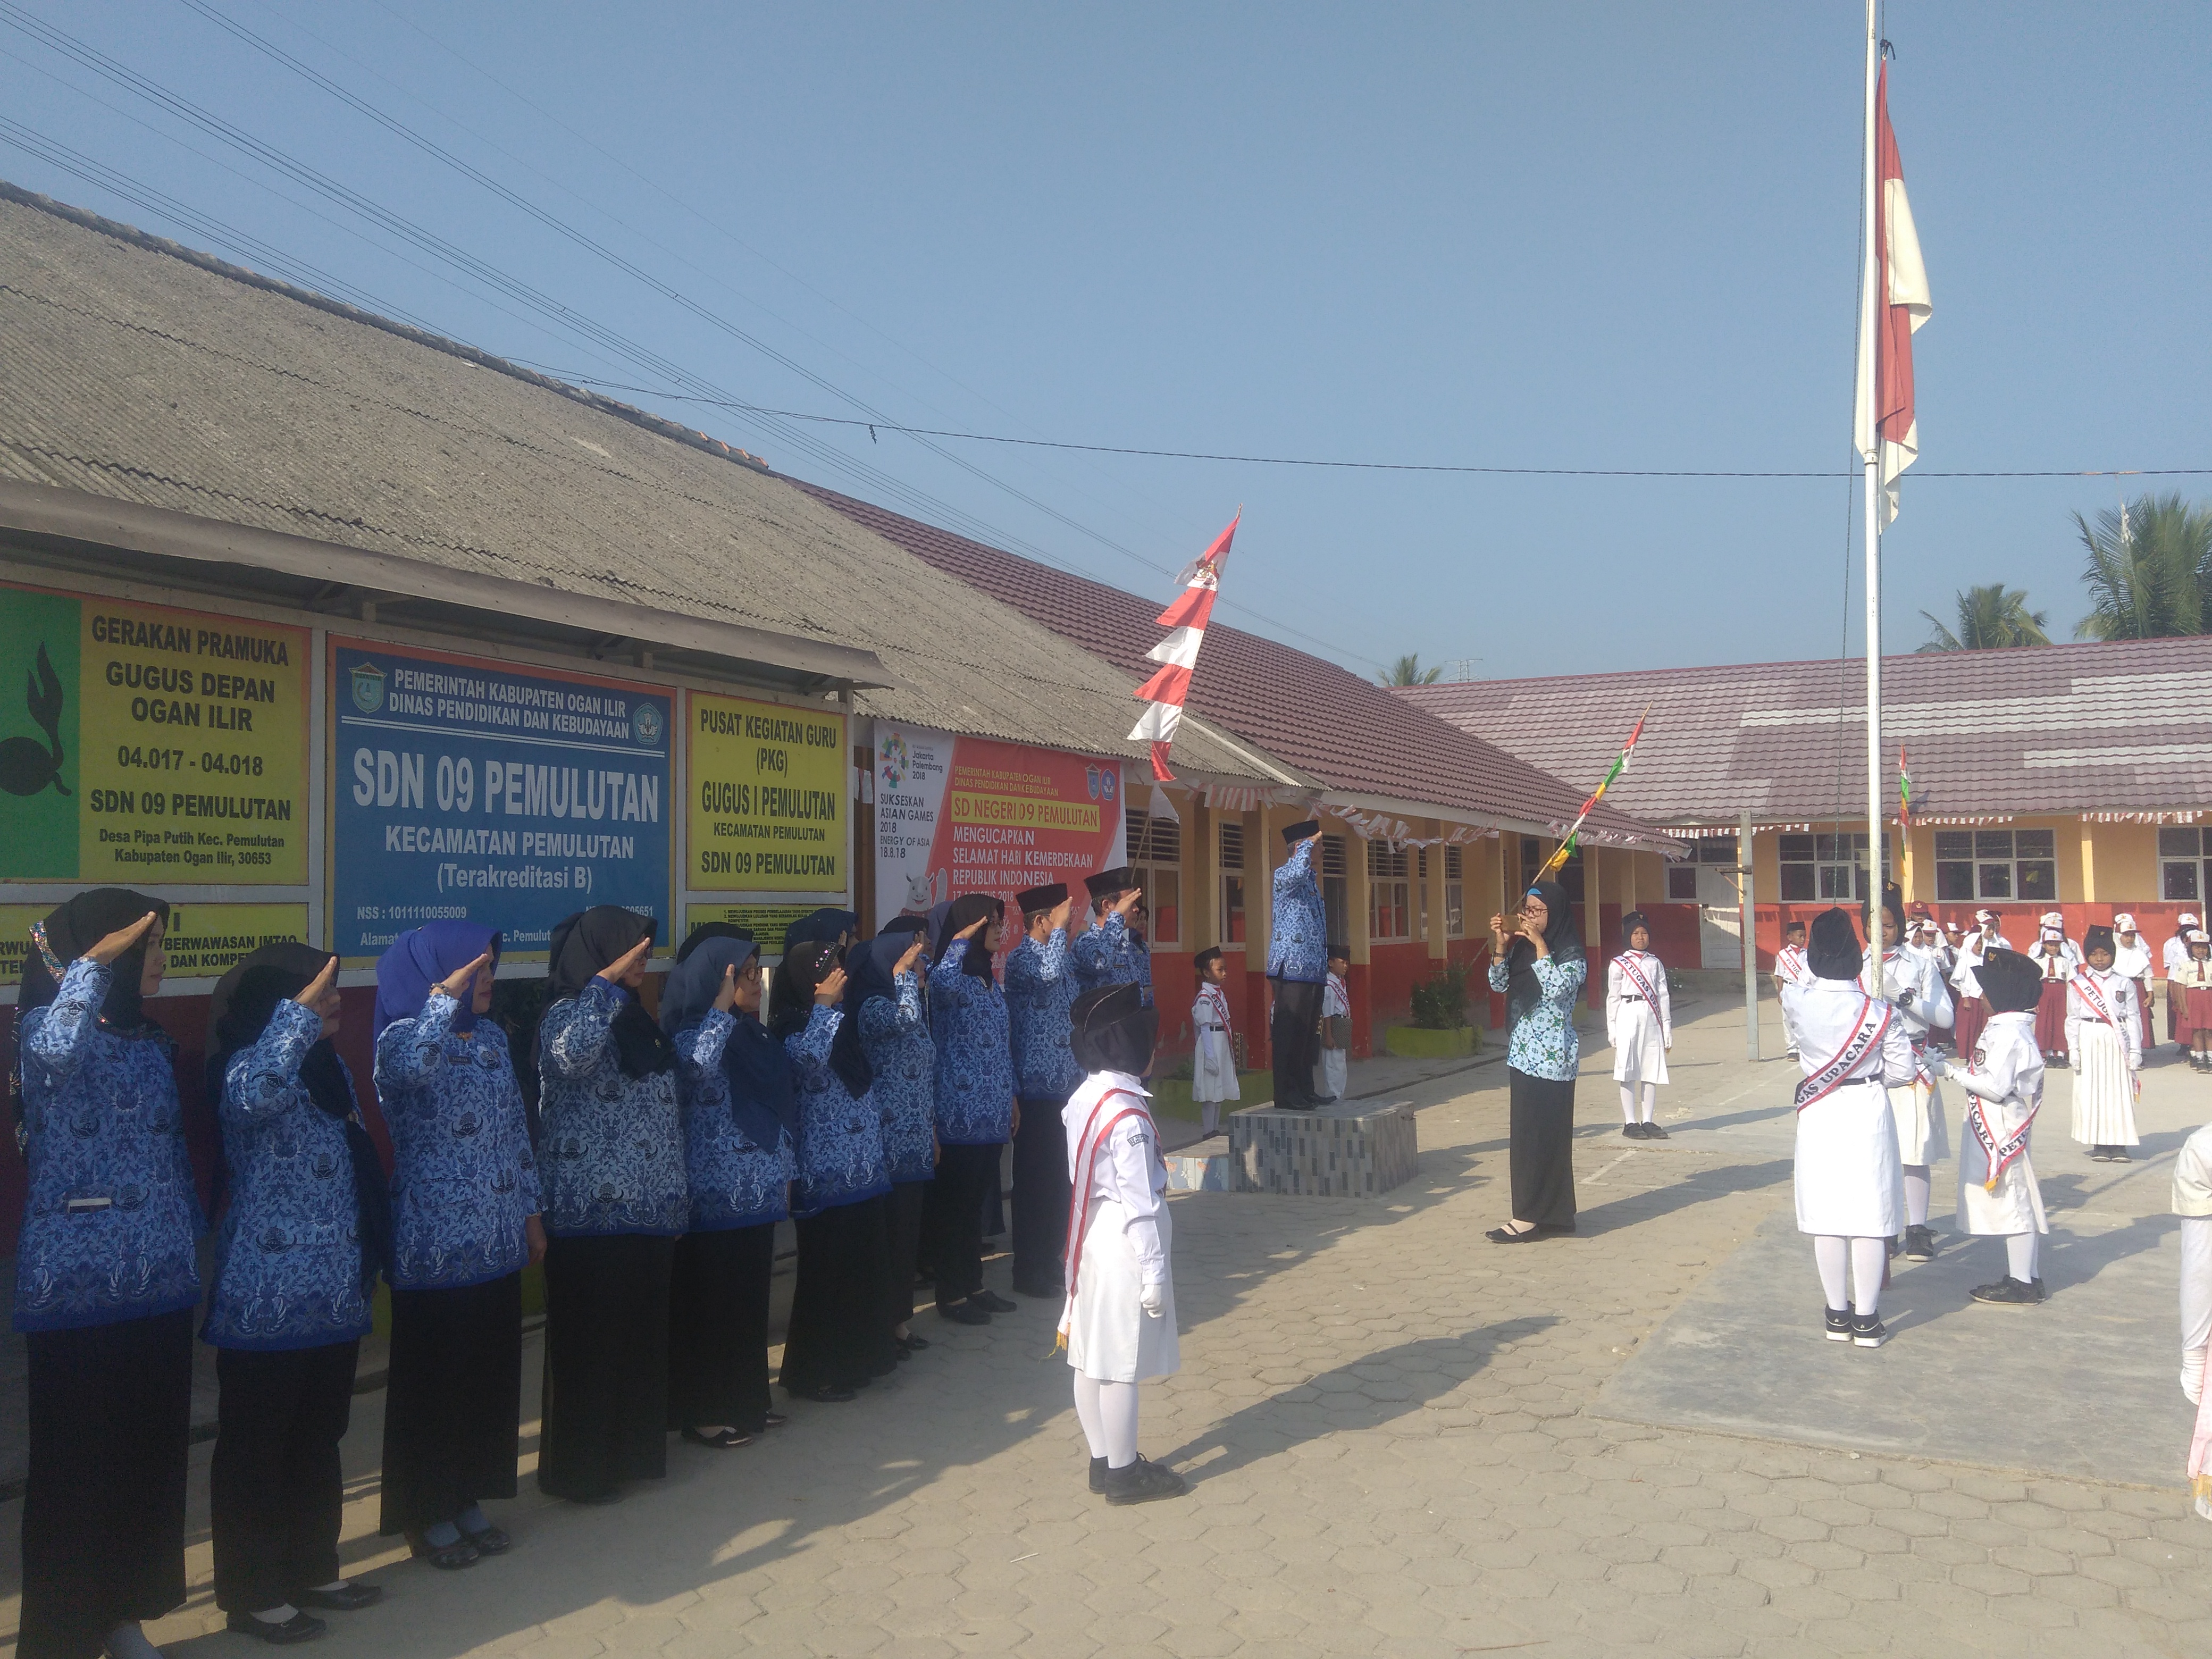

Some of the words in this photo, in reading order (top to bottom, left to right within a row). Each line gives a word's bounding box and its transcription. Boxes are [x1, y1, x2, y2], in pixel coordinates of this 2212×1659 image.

[92, 615, 191, 654] GERAKAN
[197, 630, 289, 666] PRAMUKA
[106, 661, 193, 694] GUGUS
[202, 672, 275, 702] DEPAN
[395, 668, 485, 699] PEMERINTAH
[489, 682, 564, 710] KABUPATEN
[567, 693, 601, 715] OGAN
[604, 699, 626, 717] ILIR
[131, 697, 200, 727] OGAN
[208, 705, 253, 731] ILIR
[389, 692, 433, 717] DINAS
[437, 699, 520, 727] PENDIDIKAN
[523, 710, 549, 730] DAN
[552, 715, 630, 740] KEBUDAYAAN
[701, 709, 741, 736] PUSAT
[745, 715, 803, 744] KEGIATAN
[806, 724, 836, 749] GURU
[118, 746, 183, 770] 04.017
[202, 752, 263, 776] 04.018
[756, 748, 788, 778] (PKG)
[912, 751, 934, 761] Jakarta
[912, 760, 943, 773] Palembang
[913, 771, 925, 780] 2018
[955, 766, 990, 777] PEMERINTAH
[992, 770, 1021, 782] KABUPATEN
[1023, 774, 1041, 784] OGAN
[1042, 776, 1051, 785] ILIR
[352, 747, 424, 809] SDN
[436, 755, 474, 812] 09
[485, 760, 658, 823] PEMULUTAN
[955, 777, 973, 787] DINAS
[975, 780, 1008, 791] PENDIDIKAN
[90, 789, 135, 814] SDN
[142, 792, 165, 815] 09
[172, 793, 291, 821] PEMULUTAN
[702, 781, 749, 815] GUGUS
[754, 785, 757, 815] I
[762, 786, 835, 821] PEMULUTAN
[881, 793, 924, 807] SUKSESKAN
[881, 808, 905, 820] ASIAN
[908, 810, 933, 822] GAMES
[954, 797, 970, 816] SD
[975, 799, 1016, 820] NEGERI
[1020, 803, 1034, 820] 09
[1038, 805, 1097, 826] PEMULUTAN
[714, 822, 770, 839] KECAMATAN
[773, 826, 825, 841] PEMULUTAN
[881, 822, 896, 833] 2018
[953, 826, 1034, 845] MENGUCAPKAN
[99, 829, 130, 843] Desa
[134, 830, 161, 847] Pipa
[164, 831, 194, 845] Putih
[198, 832, 223, 847] Kec.
[227, 834, 284, 848] Pemulutan
[386, 825, 516, 856] KECAMATAN
[522, 831, 633, 859] PEMULUTAN
[881, 835, 904, 845] ENERGY
[917, 838, 930, 847] ASIA
[115, 849, 180, 866] Kabupaten
[183, 851, 213, 867] Ogan
[216, 851, 234, 866] Ilir,
[238, 852, 272, 865] 30653
[881, 847, 906, 858] 18.8.18
[953, 848, 998, 864] SELAMAT
[1001, 849, 1021, 865] HARI
[1025, 851, 1093, 868] KEMERDEKAAN
[701, 851, 731, 874] SDN
[735, 852, 751, 874] 09
[756, 854, 835, 875] PEMULUTAN
[437, 862, 568, 894] (Terakreditasi
[575, 866, 592, 894] B)
[953, 869, 997, 885] REPUBLIK
[1000, 870, 1054, 886] INDONESIA
[998, 891, 1014, 902] 2018
[357, 907, 378, 919] NSS
[164, 936, 255, 951] BERWAWASAN
[514, 929, 551, 942] Pemulut
[171, 954, 197, 968] DAN
[1786, 958, 1800, 975] PETUG
[1620, 959, 1650, 992] PETUGAS
[2084, 986, 2109, 1016] PETUG
[1820, 1023, 1876, 1084] UPACARA
[1968, 1092, 1994, 1151] PACARA
